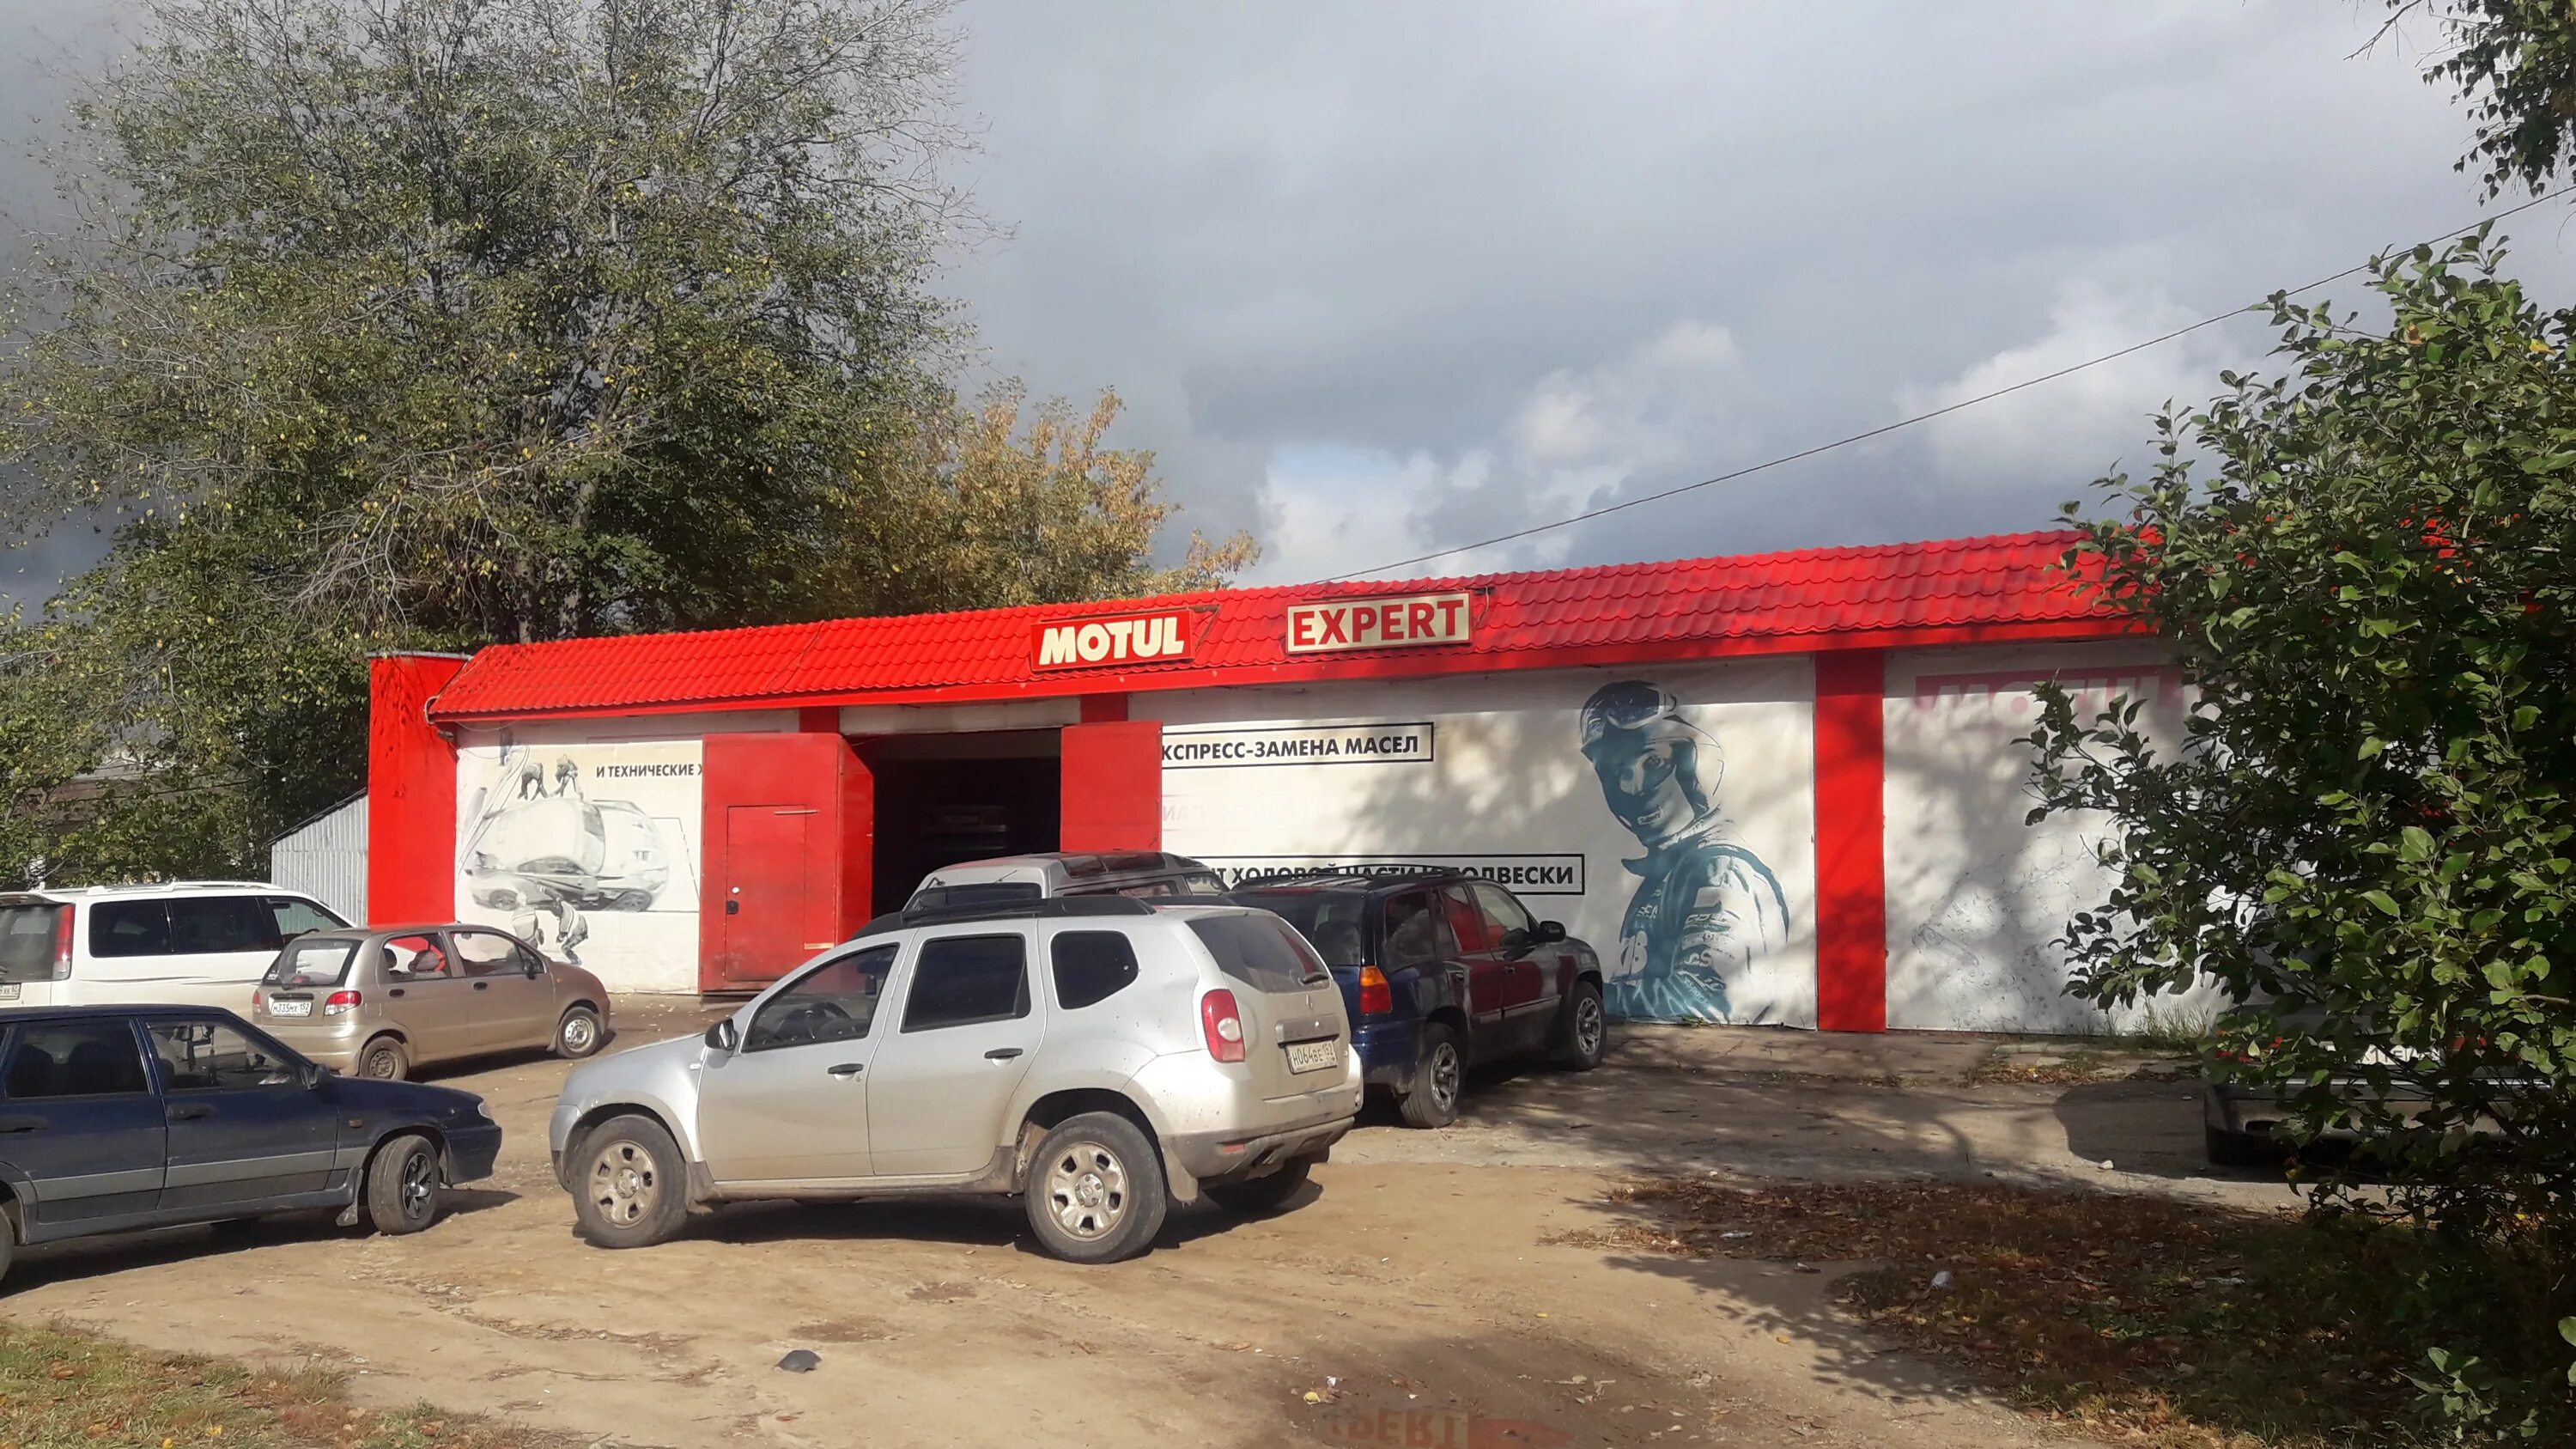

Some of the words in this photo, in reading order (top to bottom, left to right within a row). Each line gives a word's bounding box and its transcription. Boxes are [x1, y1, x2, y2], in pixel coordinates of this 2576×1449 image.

[1293, 600, 1464, 646] EXPERT
[1039, 617, 1184, 666] MOTUL
[1162, 739, 1340, 760] КСПРЕСС-ЗАМЕНА
[1345, 736, 1418, 754] МАСЕЛ
[596, 766, 605, 777] И
[608, 764, 694, 777] ТЕХНИЧЕСКИЕ
[1451, 867, 1572, 884] ОДВЕСКИ
